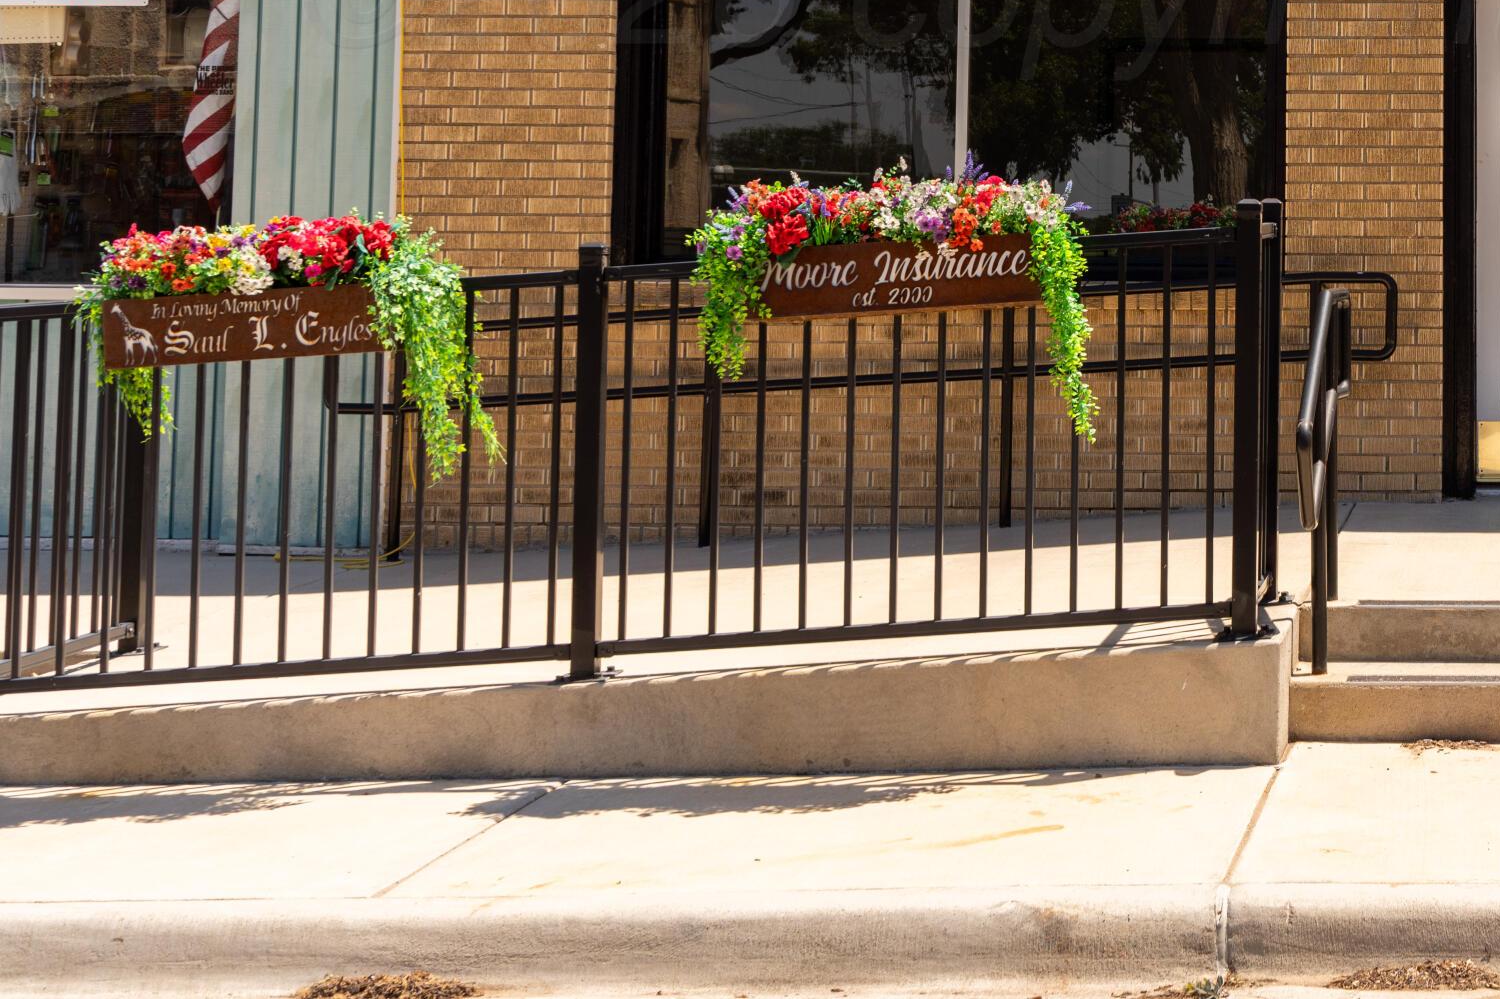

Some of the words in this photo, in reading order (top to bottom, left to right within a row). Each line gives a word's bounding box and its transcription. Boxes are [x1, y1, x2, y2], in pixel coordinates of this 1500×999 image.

[760, 259, 859, 293] Moore
[873, 249, 1030, 286] Insurance
[150, 303, 166, 320] In
[168, 301, 218, 322] Loving
[219, 298, 283, 318] Memory
[283, 291, 304, 317] Of
[887, 285, 934, 306] 2000
[163, 320, 235, 357] Saul
[248, 314, 288, 352] L.
[295, 310, 373, 352] Engles
